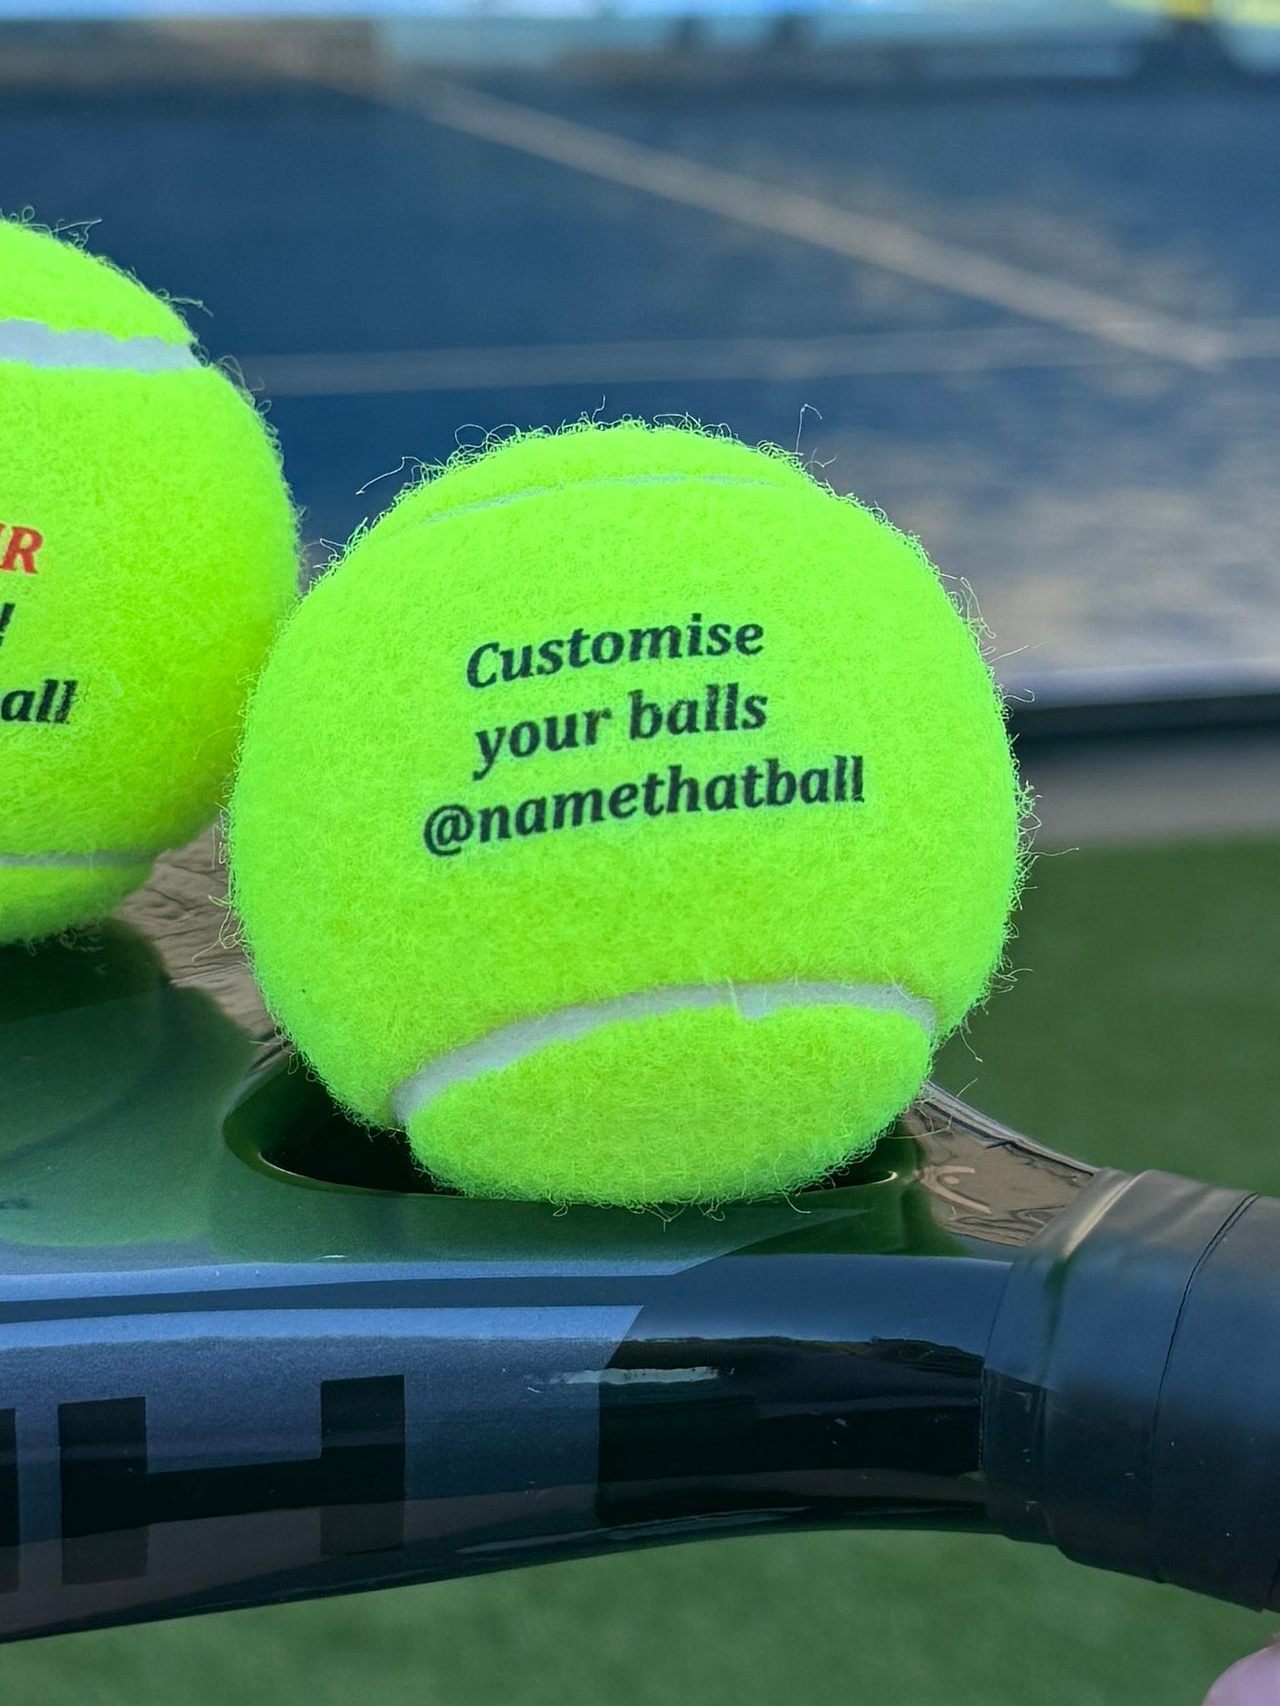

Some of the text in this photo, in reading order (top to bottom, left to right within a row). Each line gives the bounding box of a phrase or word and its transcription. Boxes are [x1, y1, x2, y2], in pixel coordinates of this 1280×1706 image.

[466, 613, 765, 689] Customise
[472, 683, 769, 781] your balls
[423, 755, 866, 858] @namethatball
